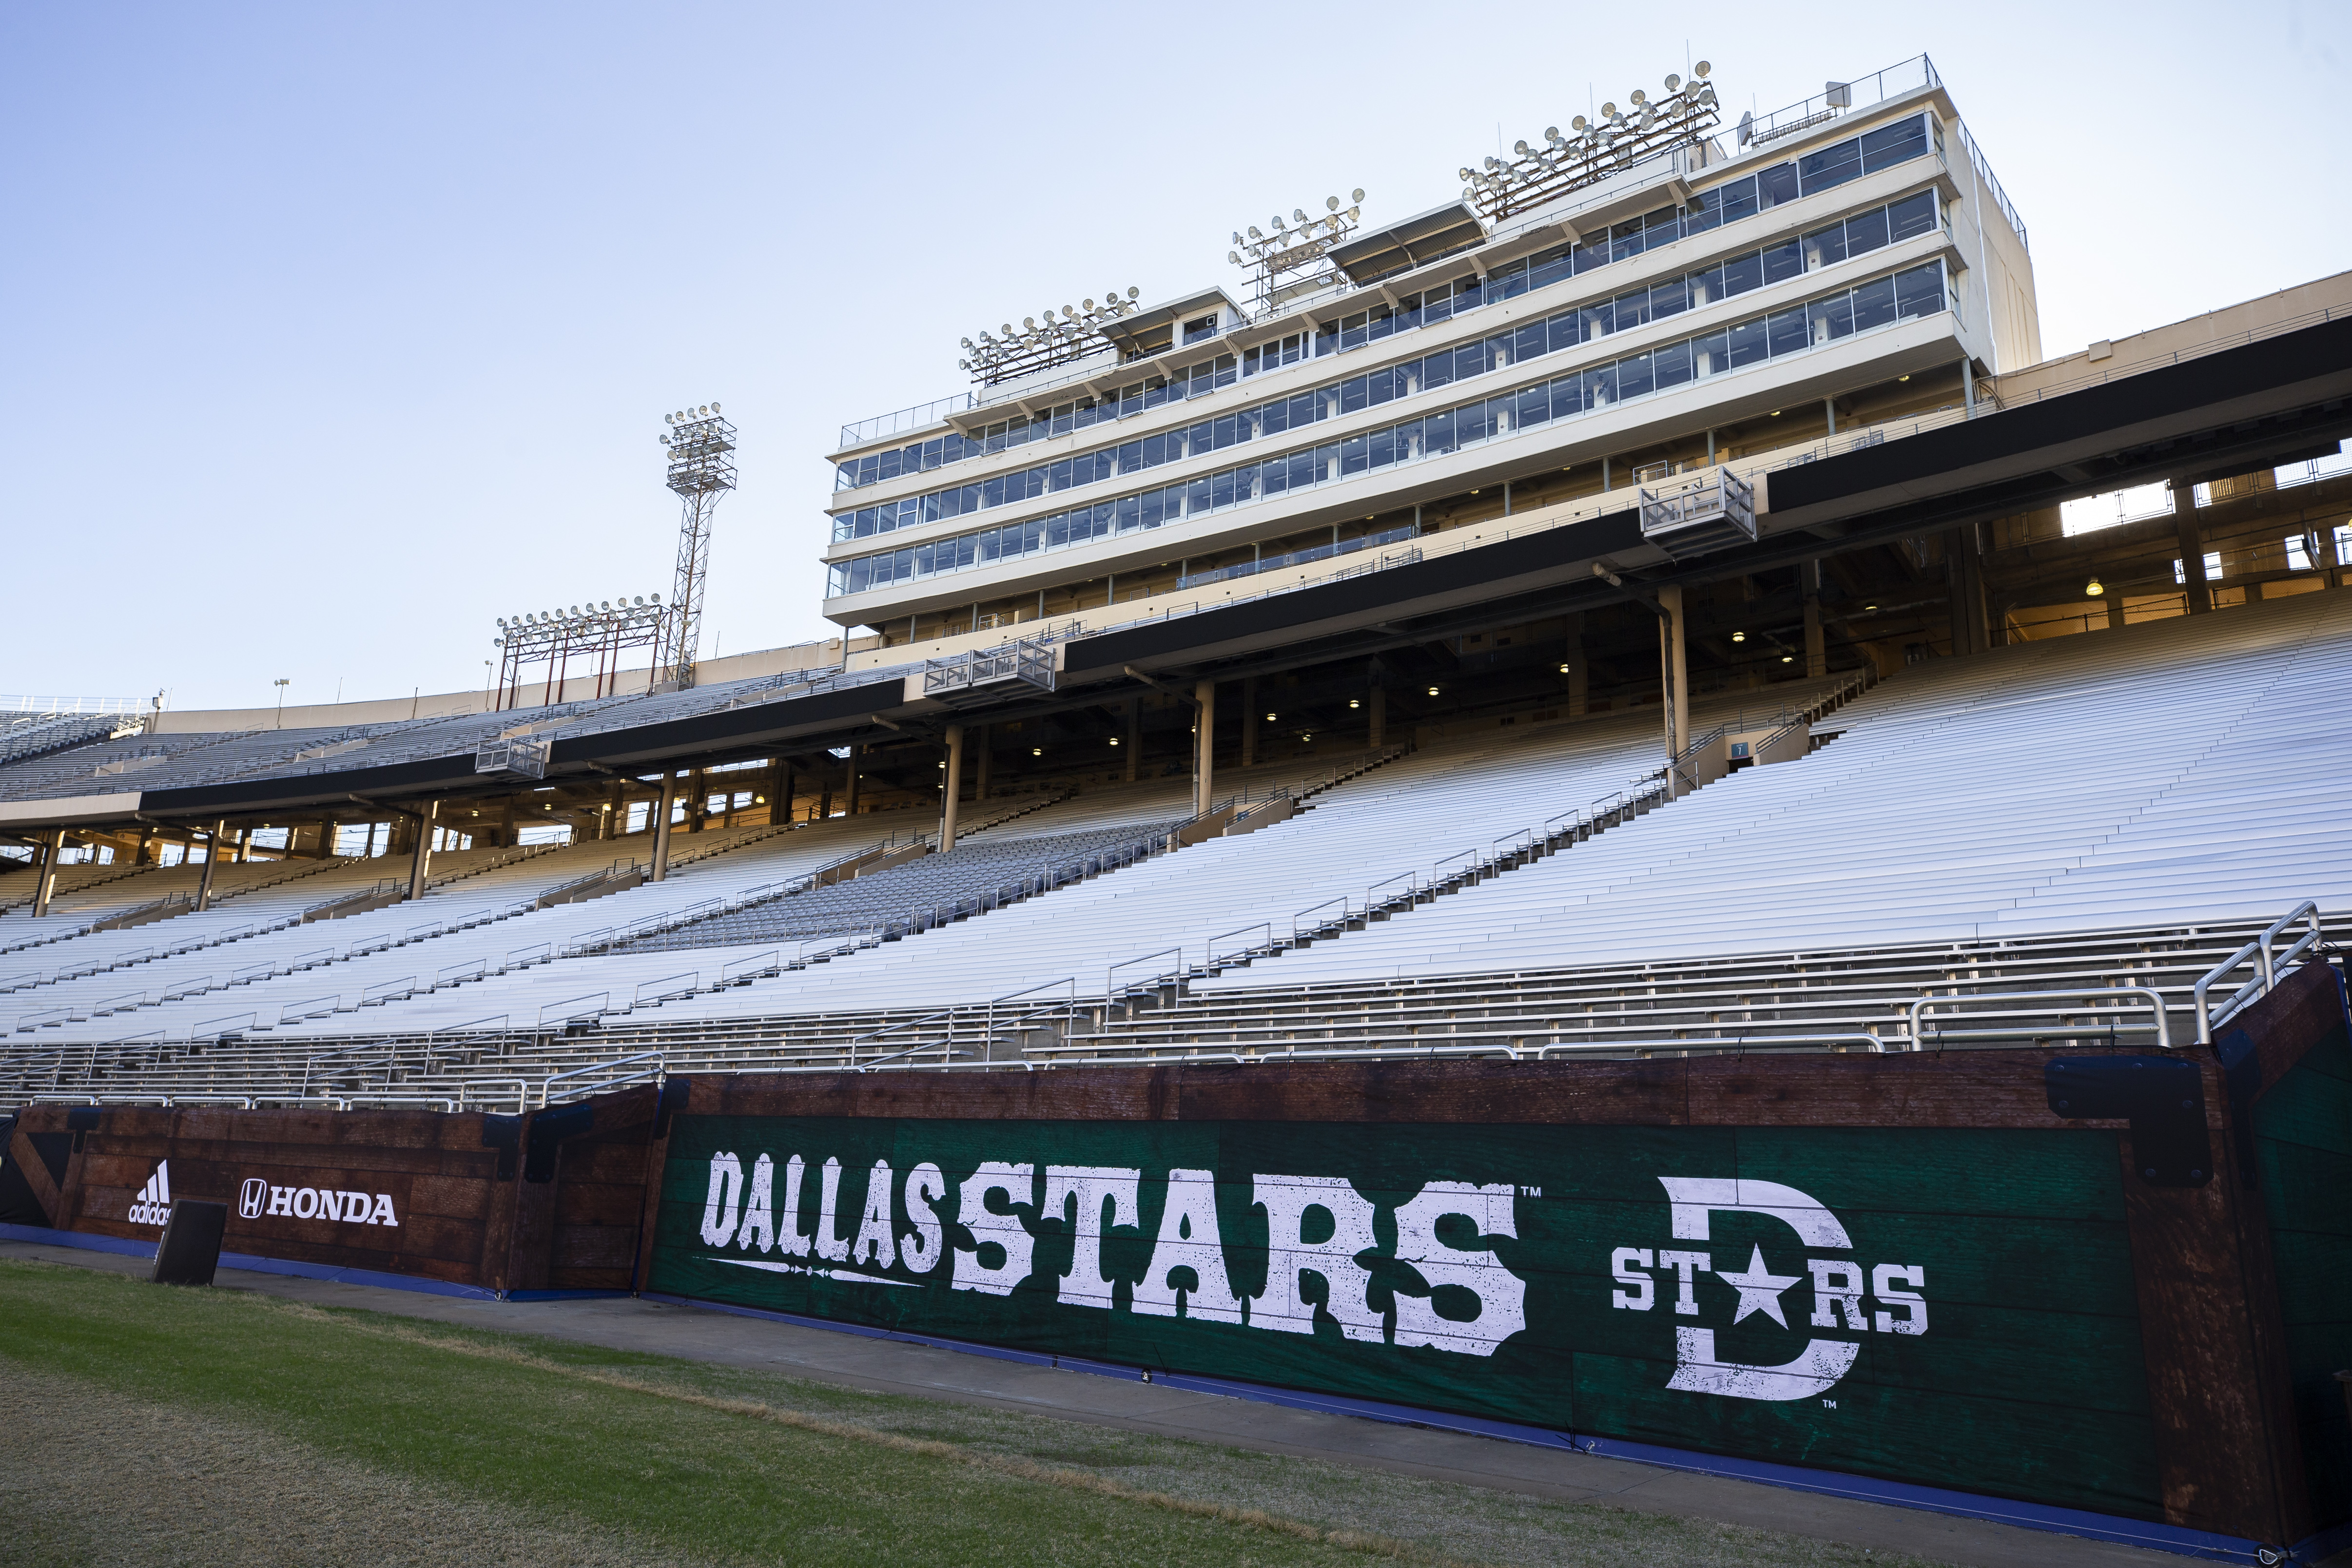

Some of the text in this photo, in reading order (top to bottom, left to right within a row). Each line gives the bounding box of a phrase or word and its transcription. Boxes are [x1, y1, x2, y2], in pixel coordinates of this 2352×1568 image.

[266, 1186, 398, 1227] HONDA
[700, 1151, 946, 1273] DALLAS
[951, 1161, 1526, 1356] STARS
